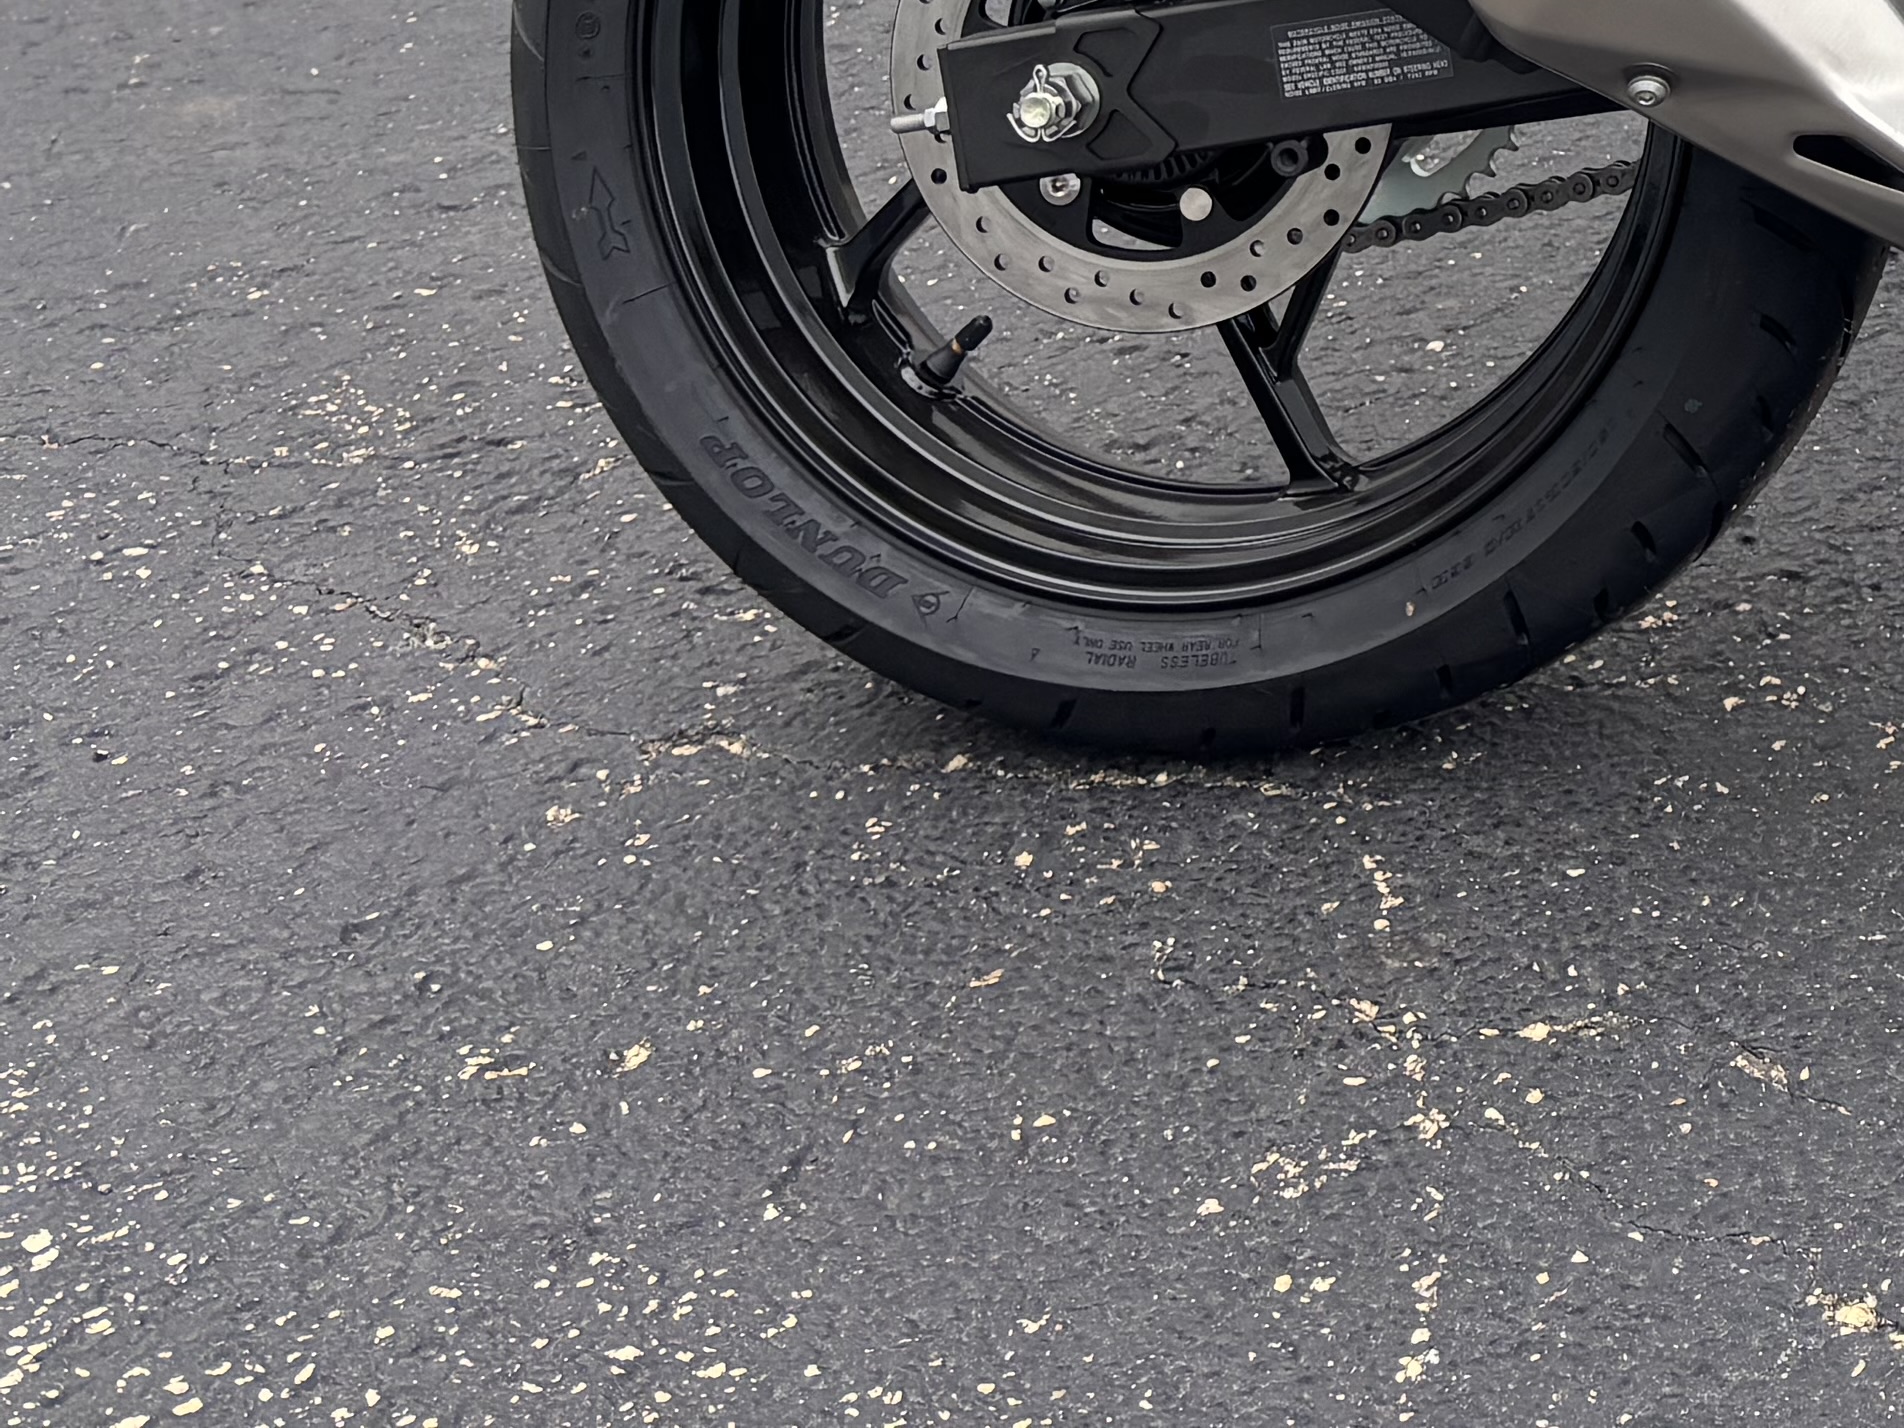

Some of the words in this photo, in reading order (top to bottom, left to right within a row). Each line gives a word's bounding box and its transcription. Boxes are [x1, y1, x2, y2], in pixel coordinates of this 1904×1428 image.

[698, 433, 909, 601] DUNLOP
[1108, 639, 1133, 651] USE
[1140, 641, 1175, 653] WHEEL
[1181, 639, 1211, 652] REAR
[1085, 651, 1137, 669] RADIAL
